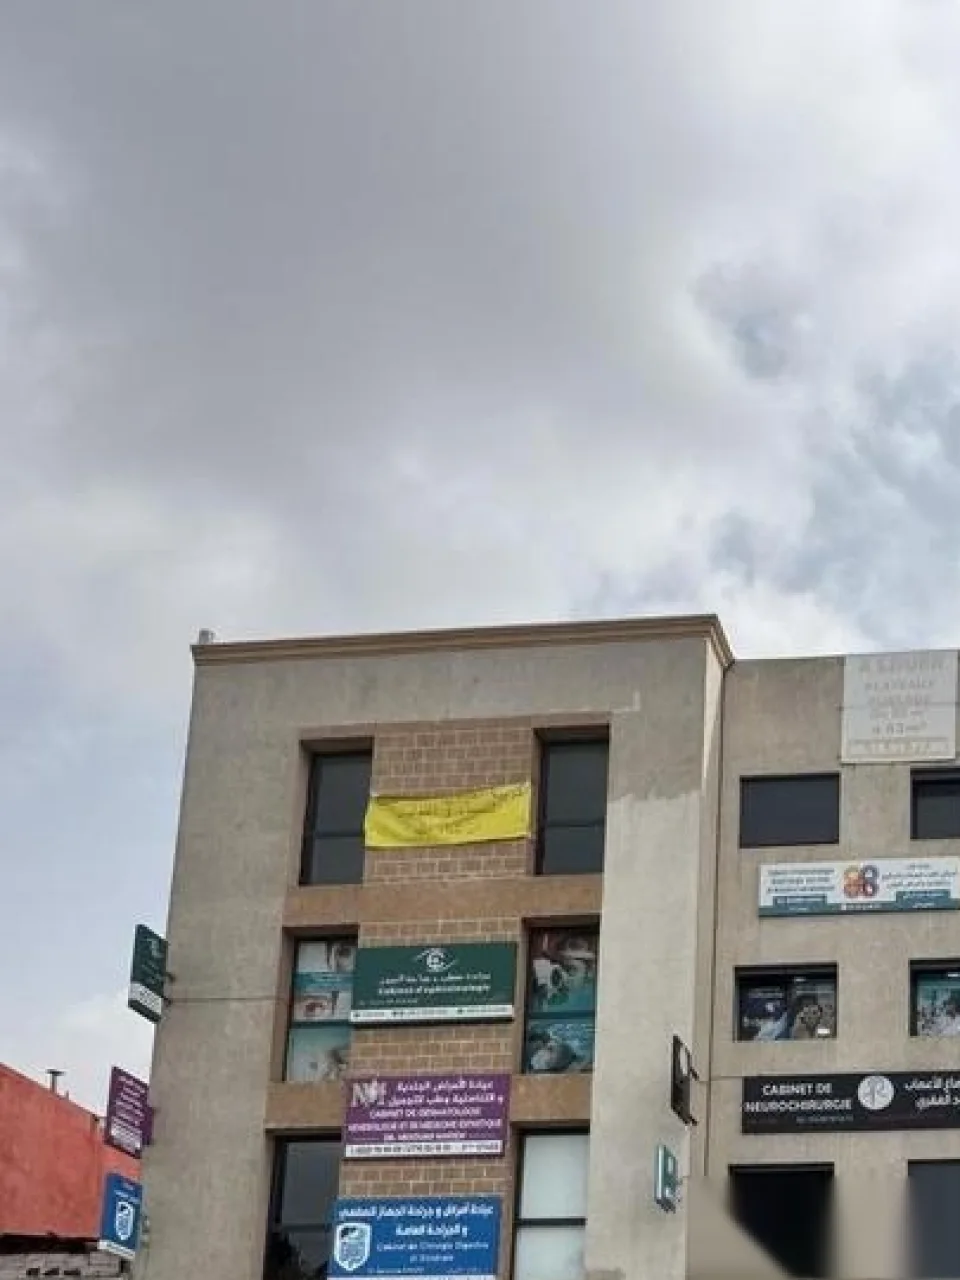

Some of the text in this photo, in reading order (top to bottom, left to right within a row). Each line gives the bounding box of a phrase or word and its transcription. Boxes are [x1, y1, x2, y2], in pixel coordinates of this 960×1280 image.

[761, 1082, 832, 1096] CABINET DE
[369, 1107, 403, 1119] CABINET
[404, 1107, 416, 1118] DE
[743, 1099, 852, 1113] NEUROCHIRURGIE
